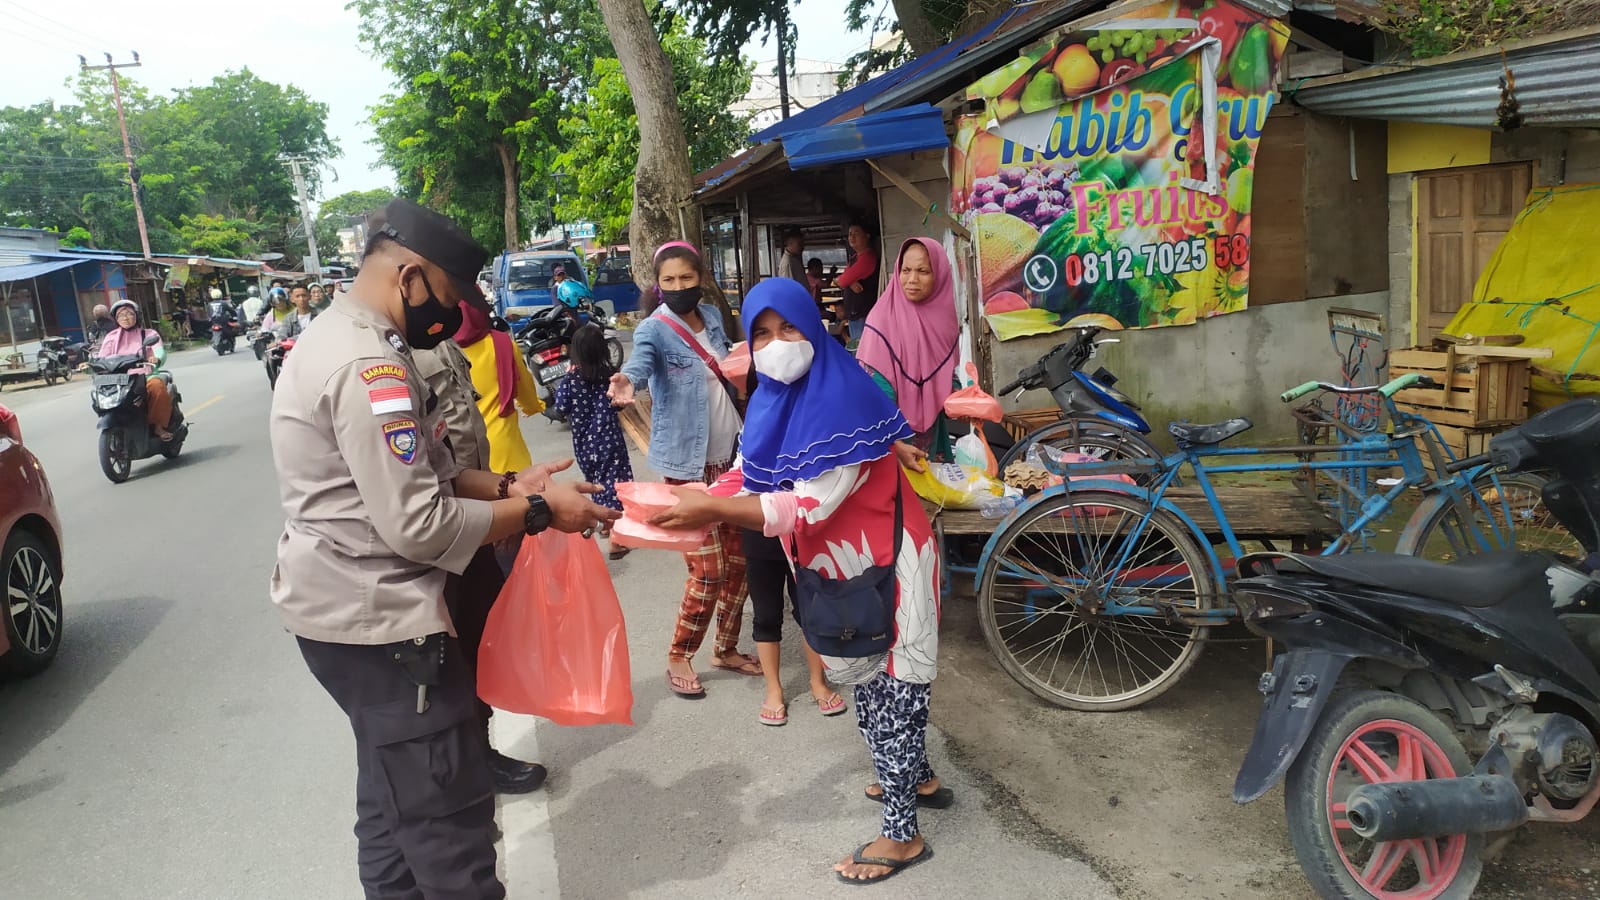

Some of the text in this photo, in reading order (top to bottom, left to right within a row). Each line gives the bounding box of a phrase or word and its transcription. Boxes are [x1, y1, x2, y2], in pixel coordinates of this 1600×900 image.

[1072, 171, 1229, 235] Fruits
[1065, 233, 1249, 287] 0812 7025 58
